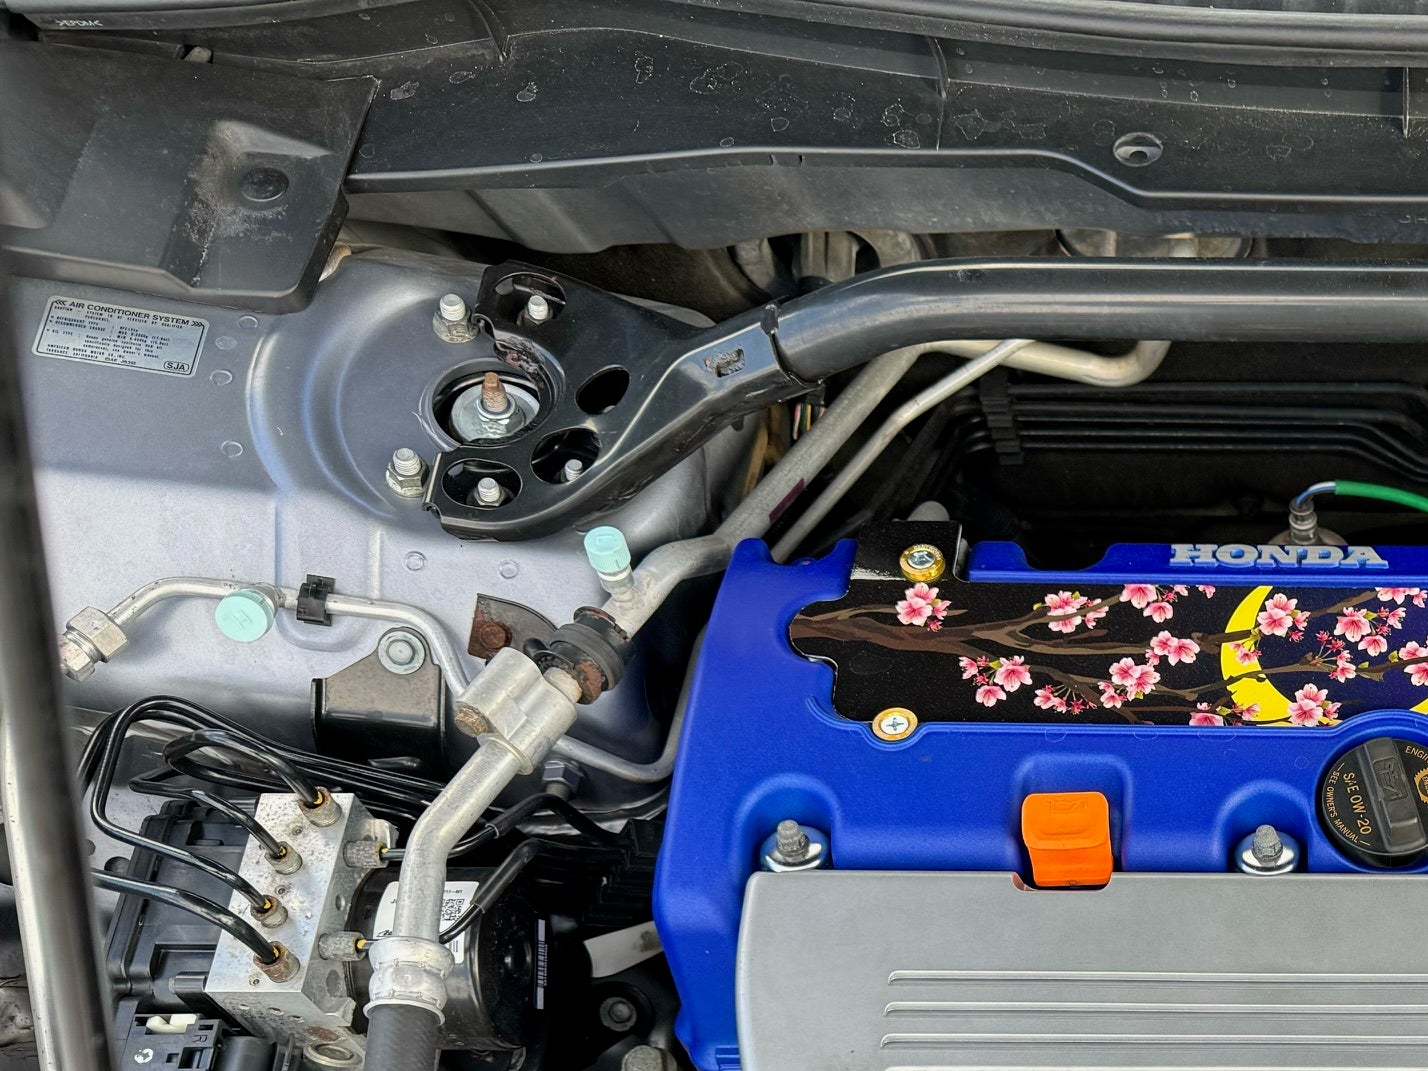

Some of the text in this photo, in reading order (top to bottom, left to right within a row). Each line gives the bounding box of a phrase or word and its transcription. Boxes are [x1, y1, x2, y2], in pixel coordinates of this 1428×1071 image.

[69, 301, 85, 309] AIR
[87, 304, 150, 320] CONDITIONER
[152, 314, 190, 326] SYSTEM
[166, 362, 186, 371] SJA
[1169, 543, 1389, 569] HONDA
[1342, 772, 1360, 794] SAE
[1326, 770, 1359, 844] SEE OWNER'S MANUAL
